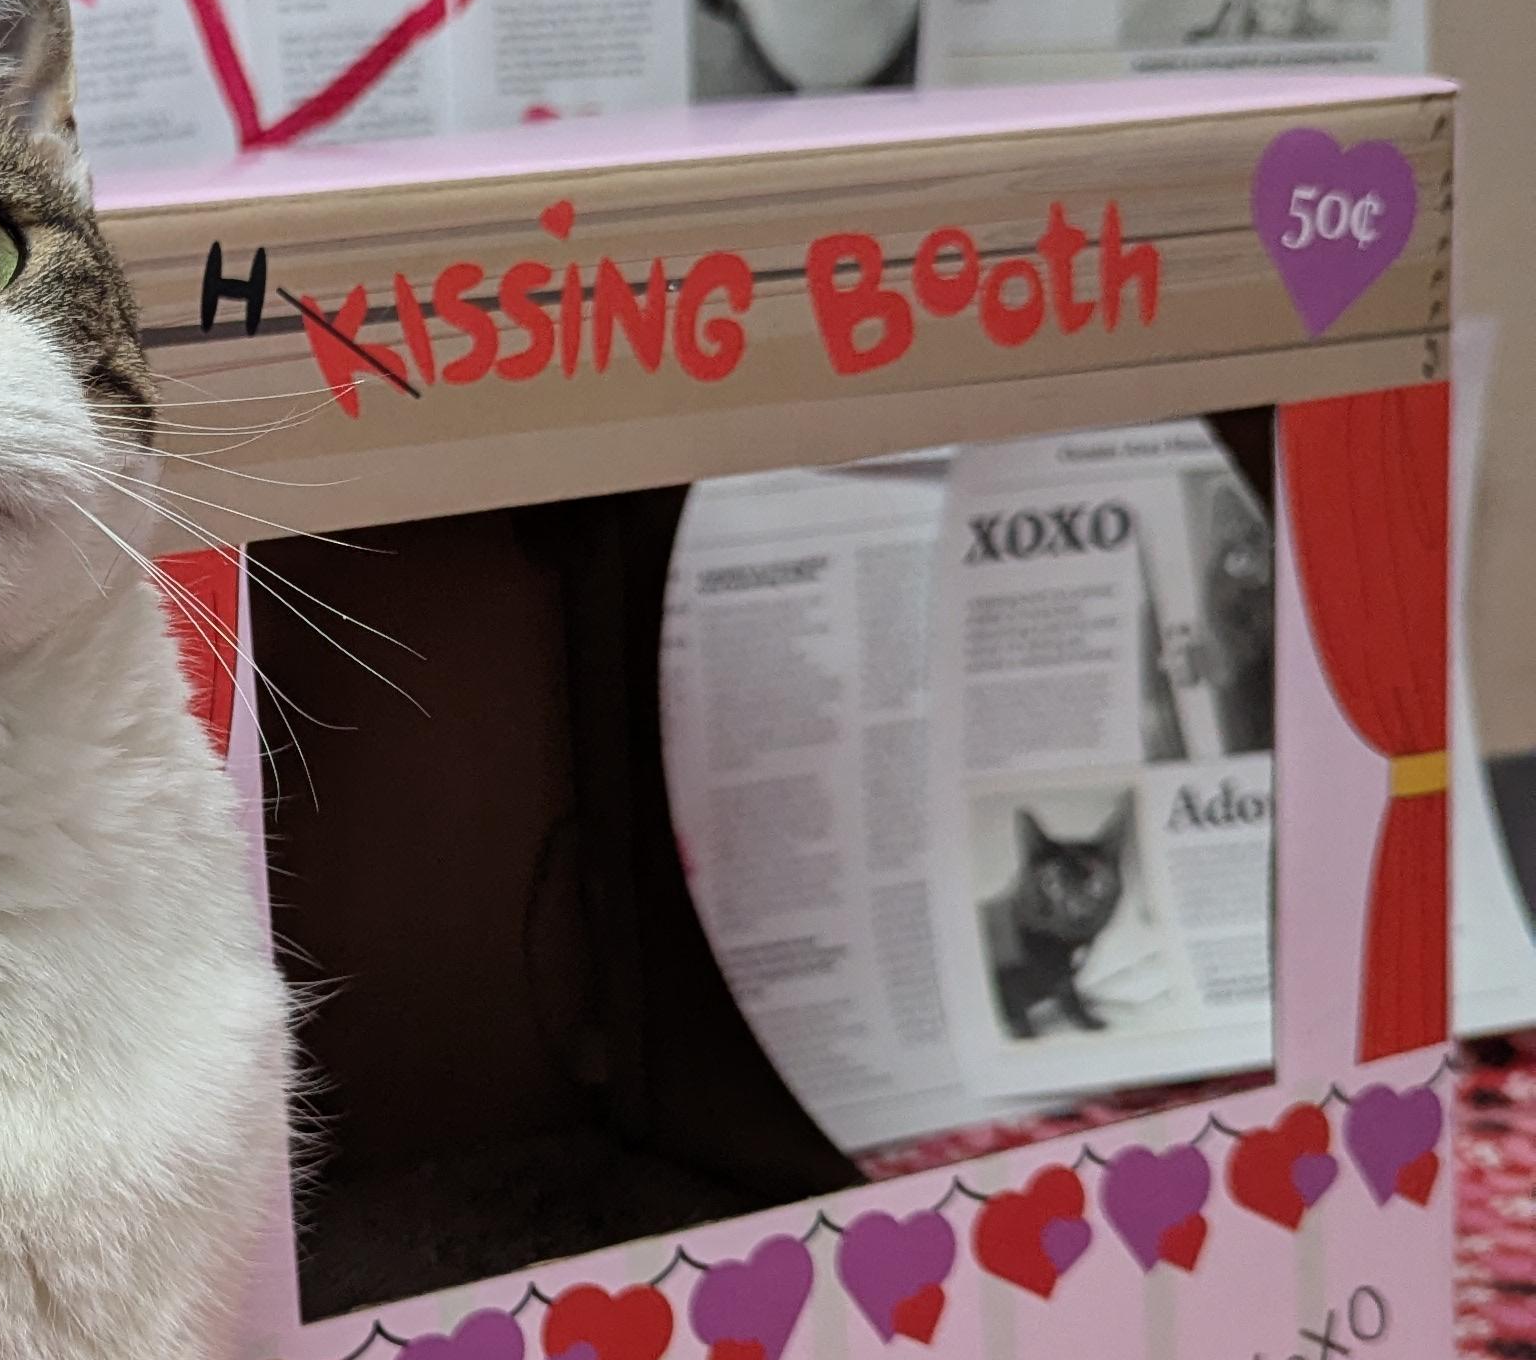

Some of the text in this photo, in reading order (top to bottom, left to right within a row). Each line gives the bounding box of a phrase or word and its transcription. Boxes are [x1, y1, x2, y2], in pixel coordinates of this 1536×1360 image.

[1279, 184, 1387, 252] 50¢
[201, 240, 267, 337] H
[965, 497, 1134, 567] XOXO
